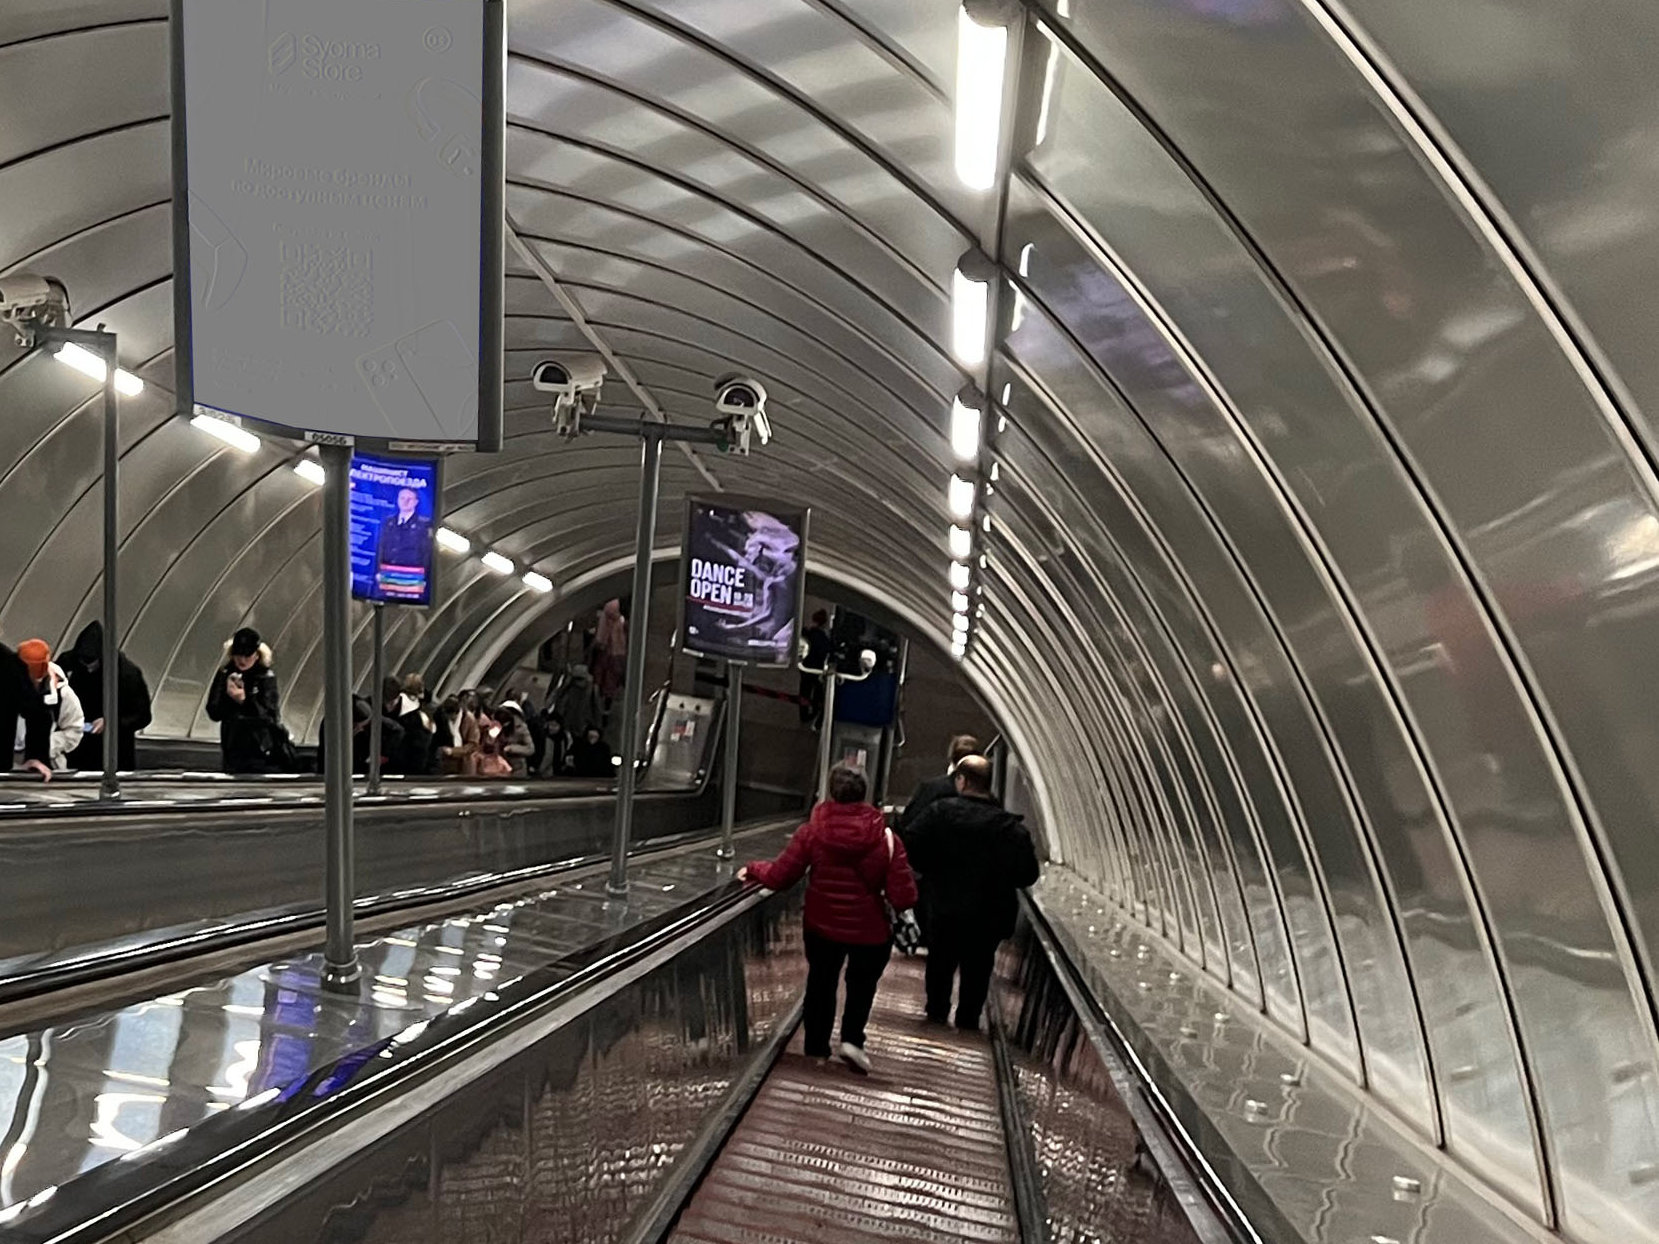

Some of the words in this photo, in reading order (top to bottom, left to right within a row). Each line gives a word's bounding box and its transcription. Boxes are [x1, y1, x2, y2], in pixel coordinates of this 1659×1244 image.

[301, 58, 363, 82] Store
[691, 558, 745, 588] DANCE
[690, 578, 732, 605] OPEN
